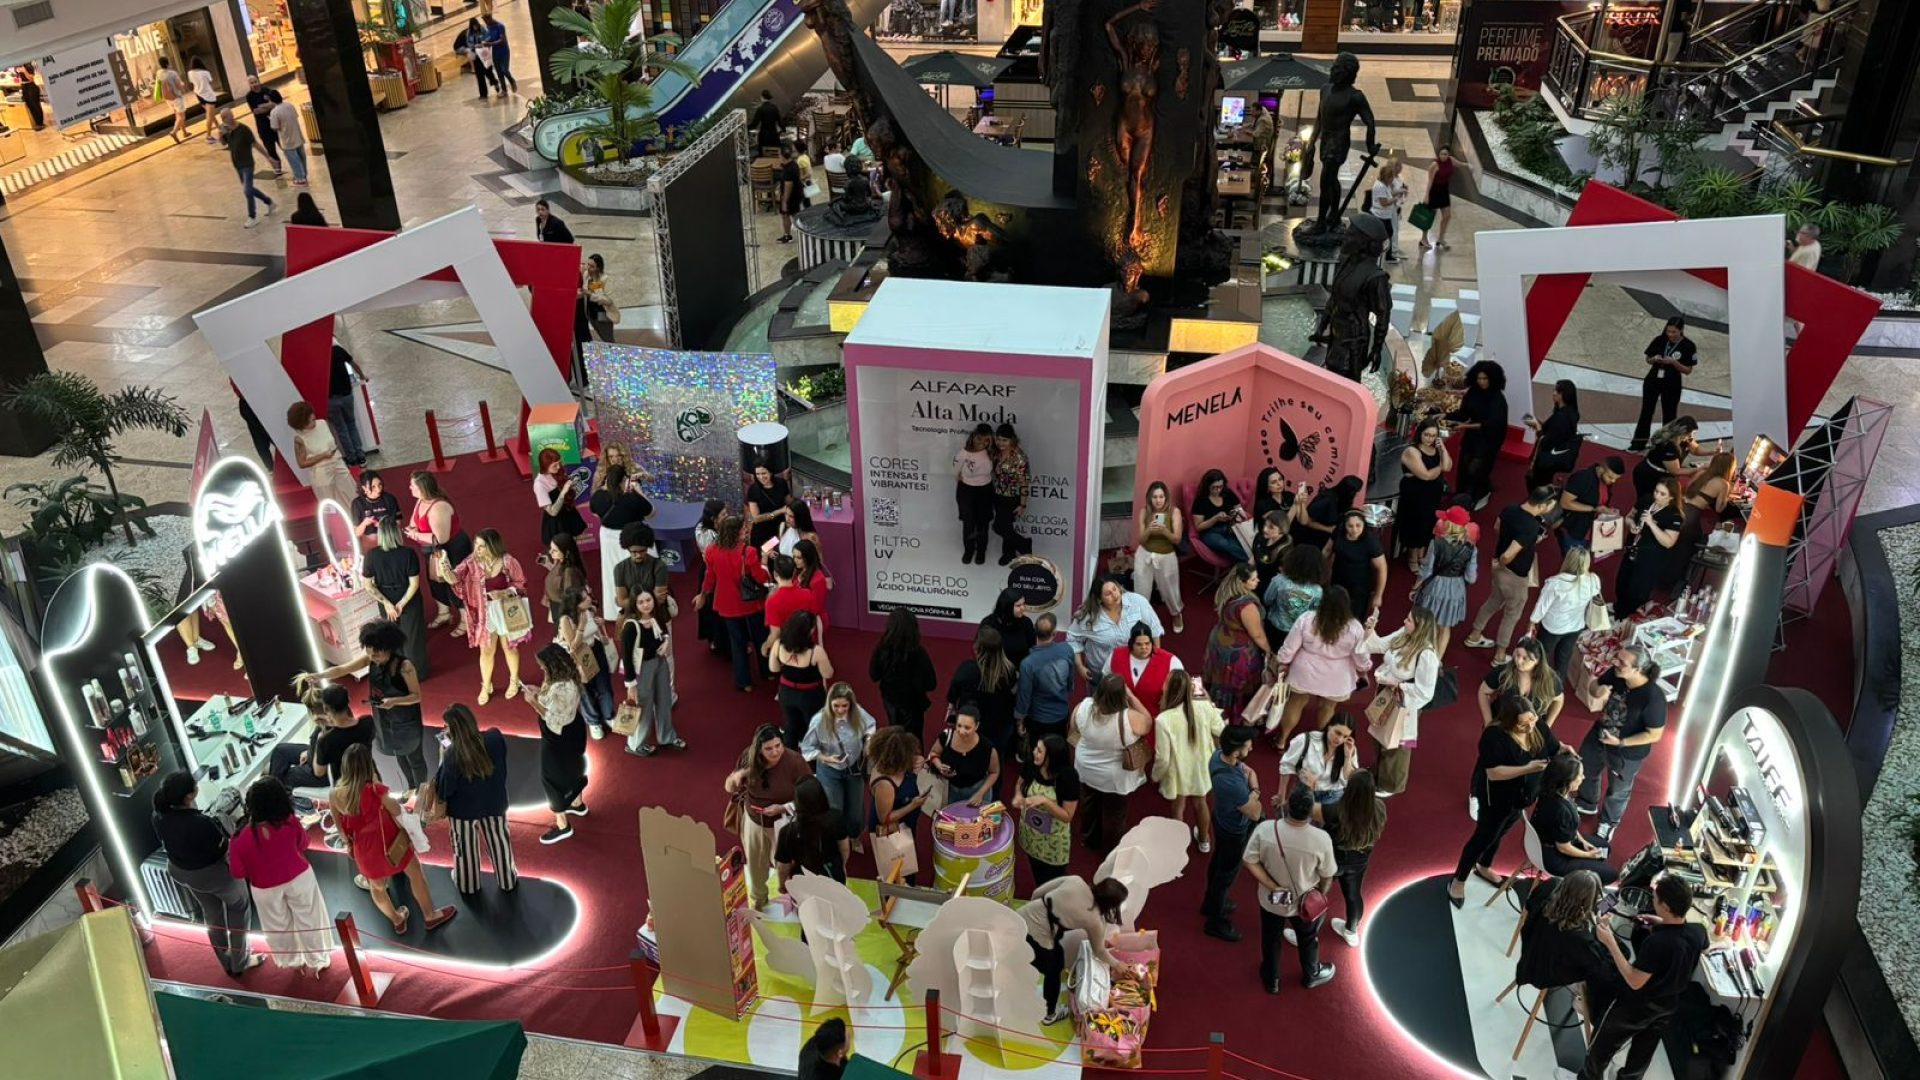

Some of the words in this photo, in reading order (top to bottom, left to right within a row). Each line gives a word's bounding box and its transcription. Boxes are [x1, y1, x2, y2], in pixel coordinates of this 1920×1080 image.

[1480, 28, 1543, 46] PERFUME
[1477, 46, 1539, 61] PREMIADO
[910, 380, 1017, 398] ALFAPARF
[911, 400, 953, 420] Alta
[958, 403, 1017, 424] Moda
[911, 425, 948, 434] Tecnologia
[1262, 398, 1294, 423] Trilhe
[1301, 401, 1322, 421] seu
[1318, 426, 1340, 492] caminho
[870, 456, 919, 470] CORES
[870, 470, 919, 481] INTENSAS
[921, 473, 928, 481] E
[871, 480, 929, 491] VIBRANTES!
[1018, 514, 1069, 526] NOLOGIA
[1031, 526, 1068, 536] BLOCK
[873, 535, 921, 548] FILTRO
[874, 549, 894, 559] UV
[876, 571, 888, 582] O
[892, 572, 942, 586] PODER
[946, 576, 968, 589] DO
[876, 582, 905, 592] ÁCIDO
[906, 585, 969, 598] HIALURÔNICO
[1743, 712, 1792, 807] TAIFF
